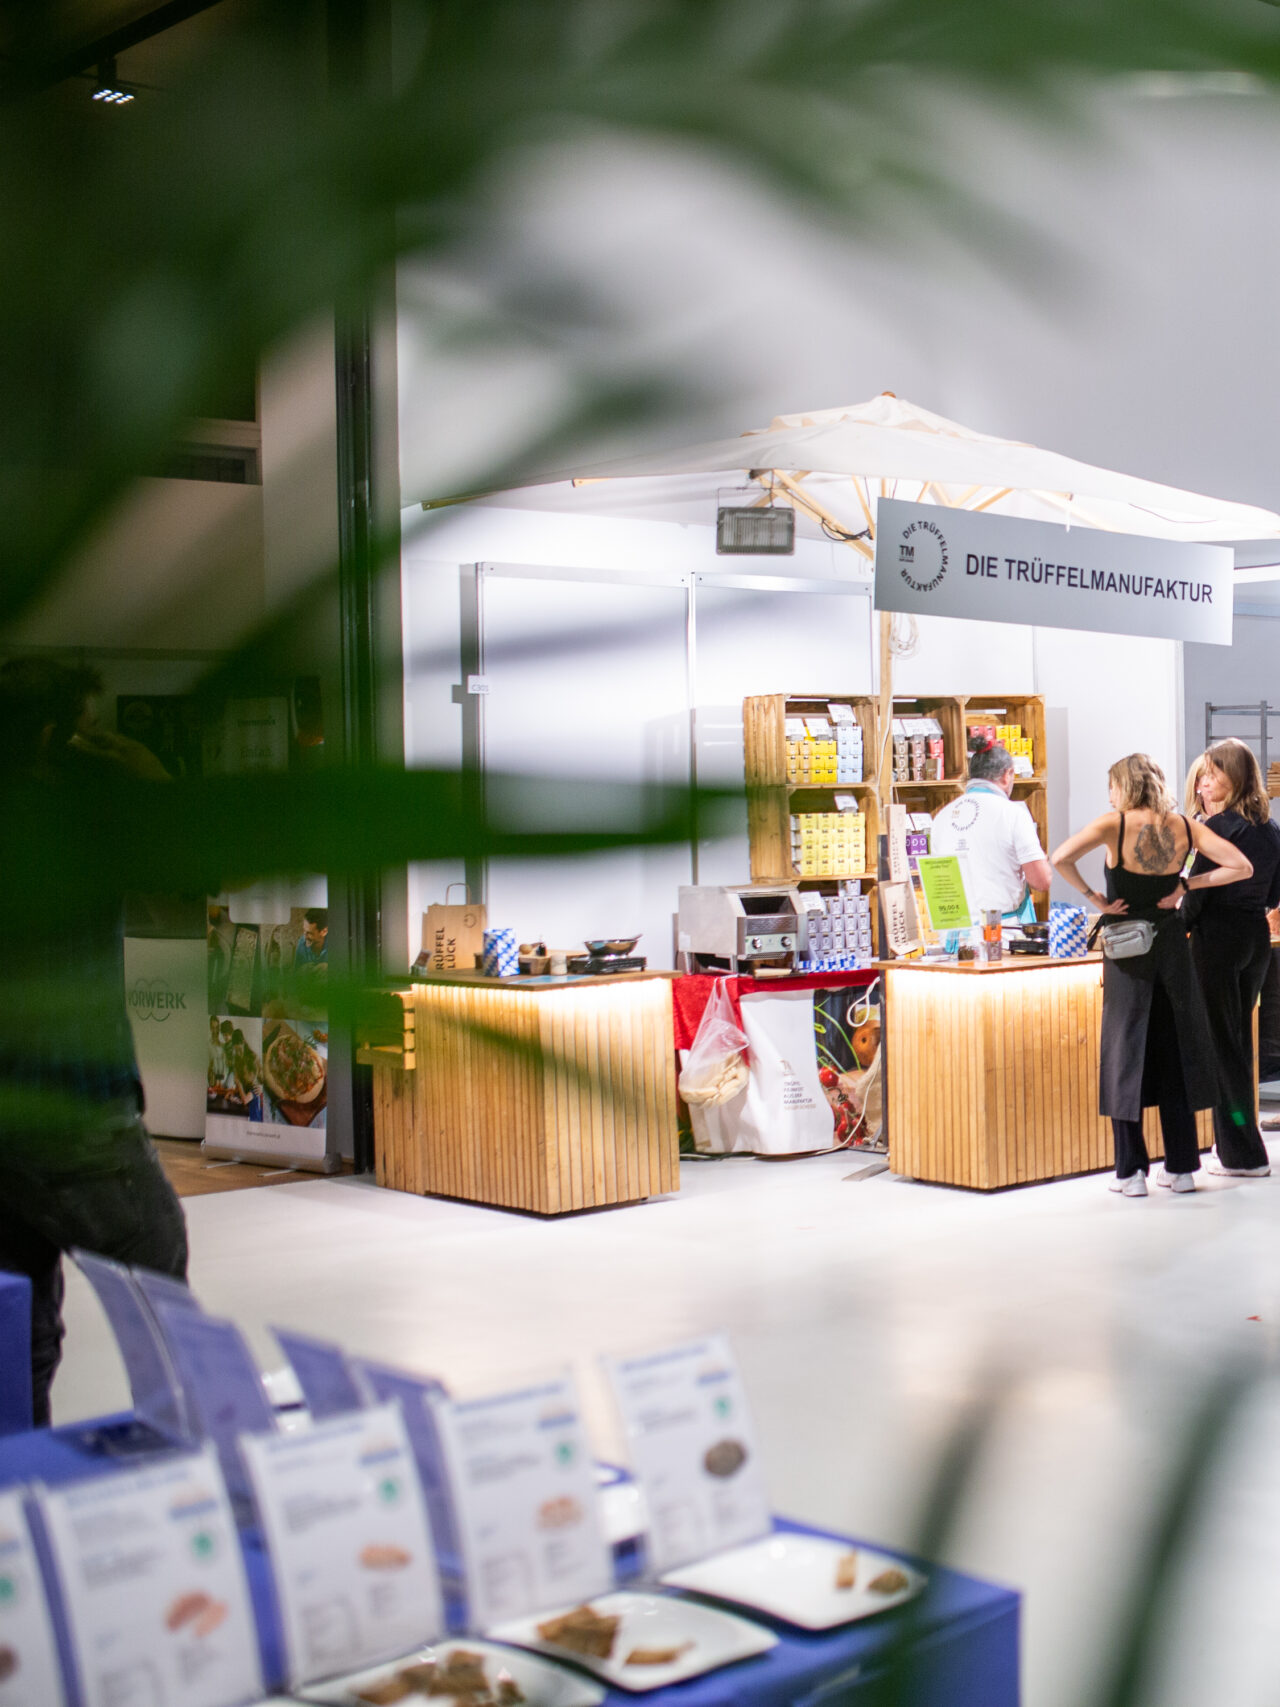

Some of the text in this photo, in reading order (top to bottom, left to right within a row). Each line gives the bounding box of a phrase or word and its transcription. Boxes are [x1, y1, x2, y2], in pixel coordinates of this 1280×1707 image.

[902, 523, 917, 539] DIE
[900, 545, 914, 556] TM
[901, 521, 948, 592] TRÜFFELMANUFAKTUR
[966, 554, 1213, 604] DIE TRÜFFELMANUFAKTUR
[433, 927, 445, 970] RÜFFEL
[446, 938, 456, 969] LÜCK
